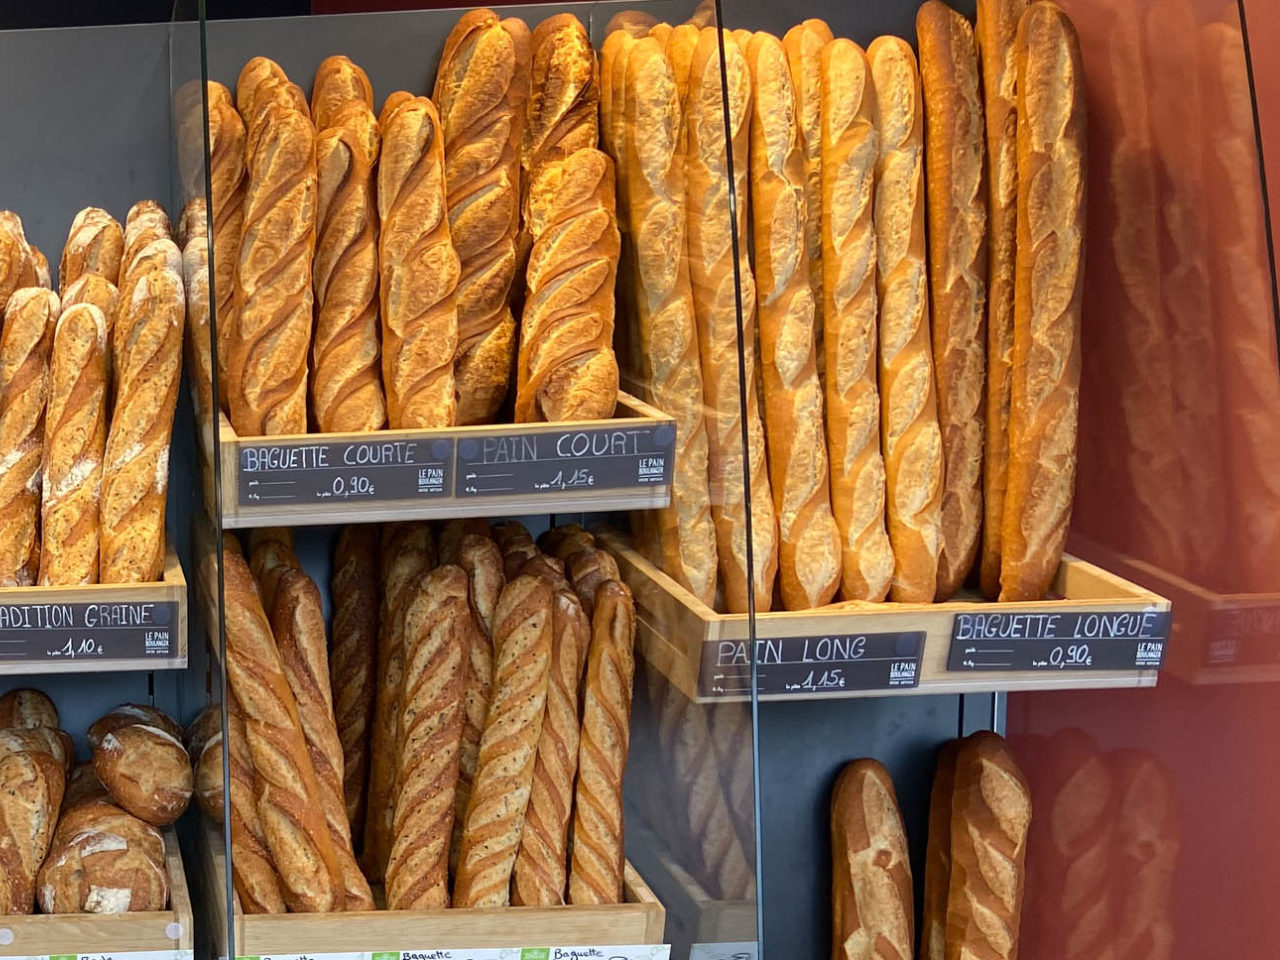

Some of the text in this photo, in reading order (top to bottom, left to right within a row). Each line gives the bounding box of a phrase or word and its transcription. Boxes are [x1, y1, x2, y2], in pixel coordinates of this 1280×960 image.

[243, 442, 417, 472] BAGUETTE COURTE
[482, 430, 650, 464] PAIN COURT
[85, 604, 154, 627] GRAINE
[956, 613, 1157, 639] BAGUETTE LONGUE
[717, 636, 866, 667] PAIN LONG
